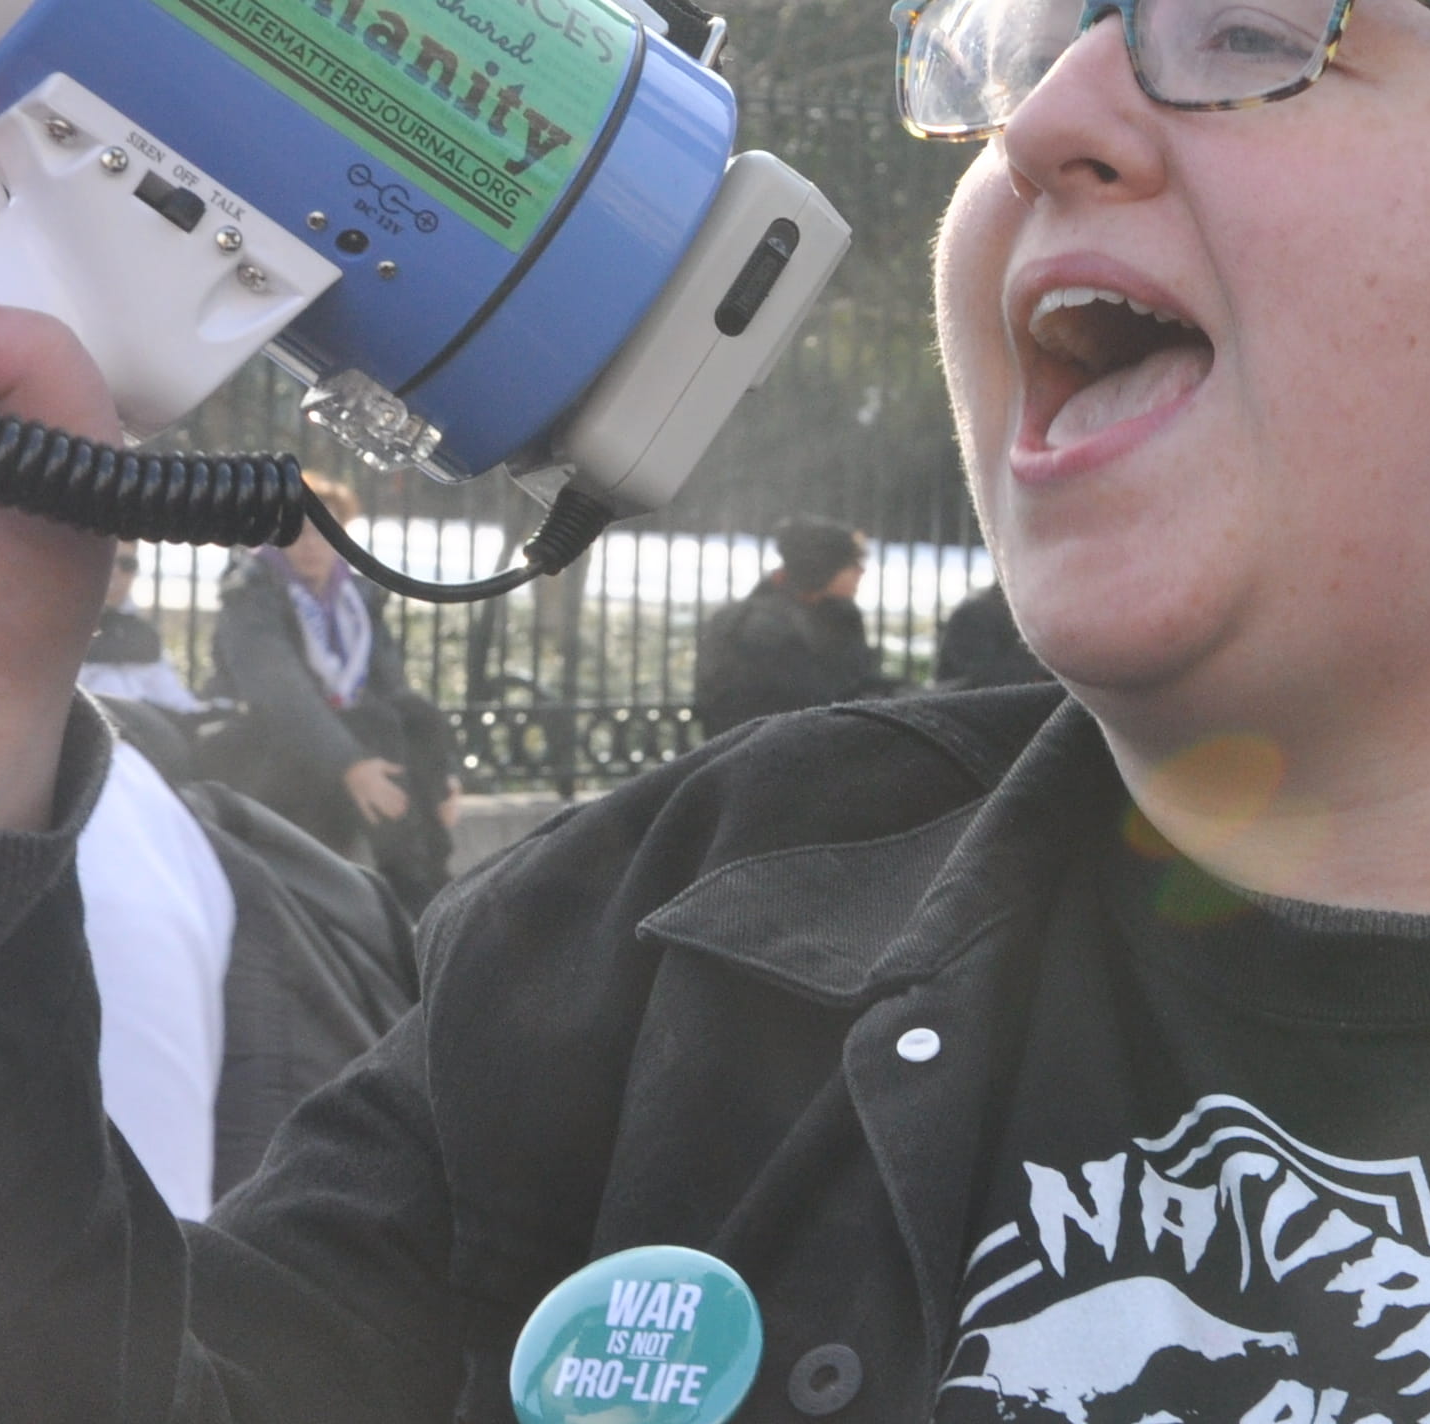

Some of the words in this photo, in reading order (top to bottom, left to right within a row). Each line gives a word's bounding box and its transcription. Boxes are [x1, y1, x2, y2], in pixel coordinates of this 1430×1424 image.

[125, 131, 167, 164] SIREN
[173, 164, 201, 188] OFF
[210, 190, 246, 222] TALK
[353, 198, 378, 217] DC
[377, 215, 404, 235] 12V
[605, 1279, 703, 1332] WAR
[606, 1329, 629, 1355] IS
[630, 1332, 674, 1357] NOT
[553, 1357, 708, 1406] PRO-LIFE
